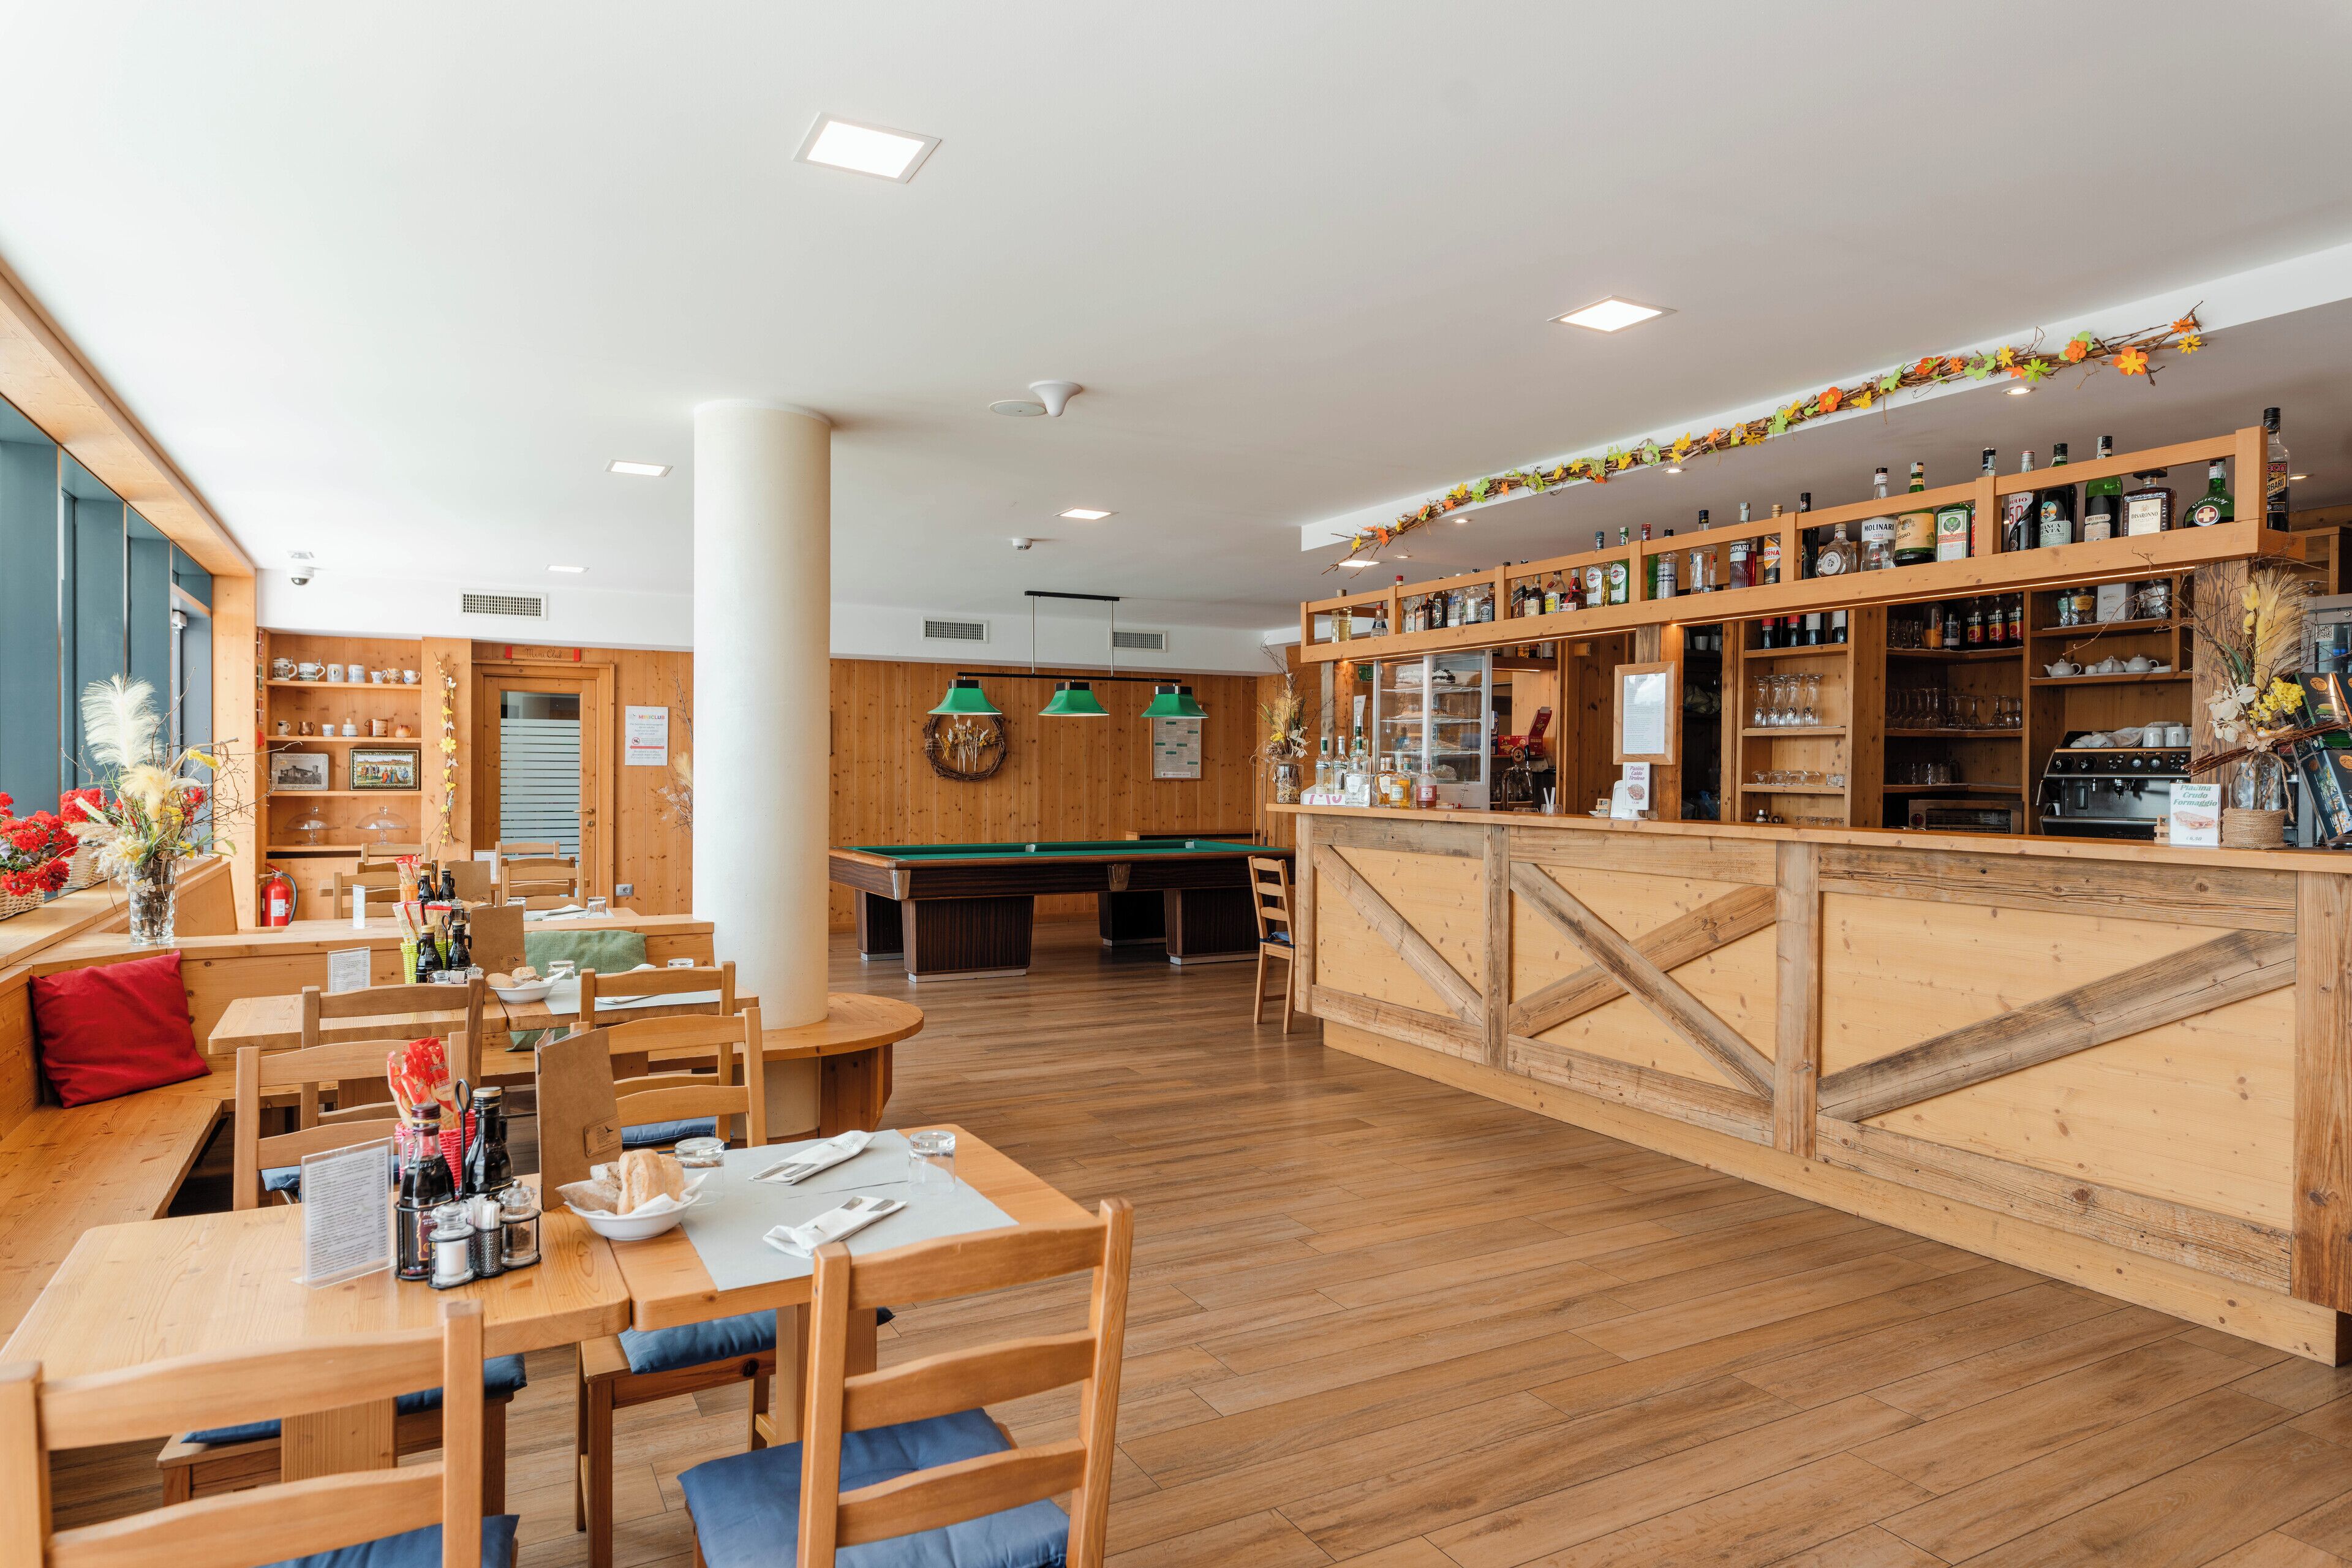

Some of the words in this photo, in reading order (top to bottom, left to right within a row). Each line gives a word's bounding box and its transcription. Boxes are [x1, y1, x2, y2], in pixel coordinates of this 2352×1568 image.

[2192, 497, 2228, 508] UNICUM
[2009, 505, 2024, 525] 50
[1864, 524, 1894, 532] MOLINARI
[546, 649, 562, 659] Club
[2173, 799, 2217, 807] Formaggio
